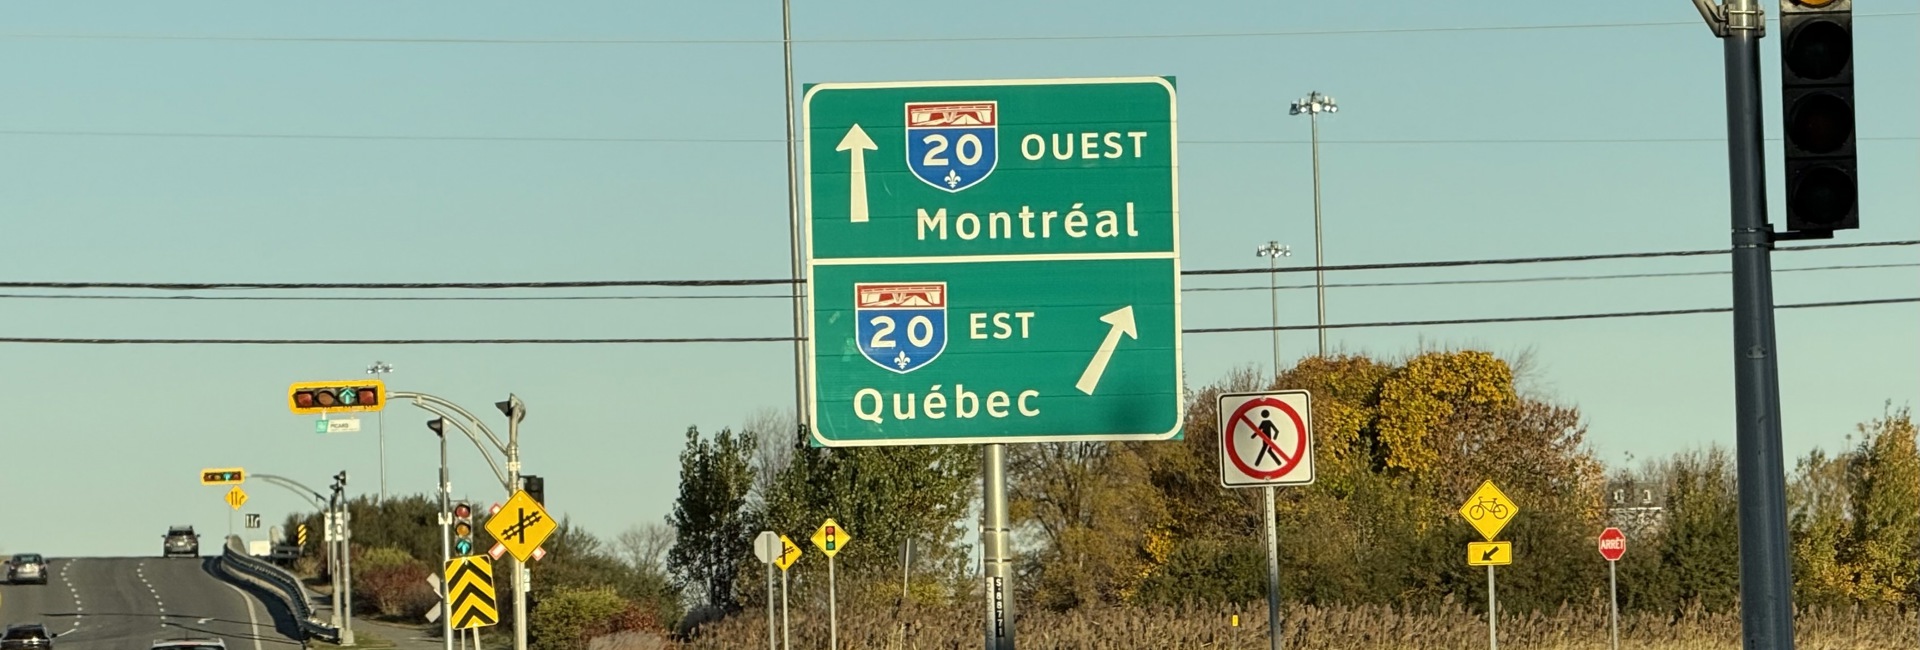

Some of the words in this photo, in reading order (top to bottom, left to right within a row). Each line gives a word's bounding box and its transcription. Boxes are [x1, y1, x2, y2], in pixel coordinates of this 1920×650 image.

[922, 133, 983, 167] 20
[1020, 131, 1148, 161] OUEST
[916, 202, 1139, 241] Montréal
[869, 315, 934, 348] 20
[969, 311, 1035, 340] EST
[853, 384, 1041, 424] Québec
[1601, 537, 1624, 549] ARRÊT
